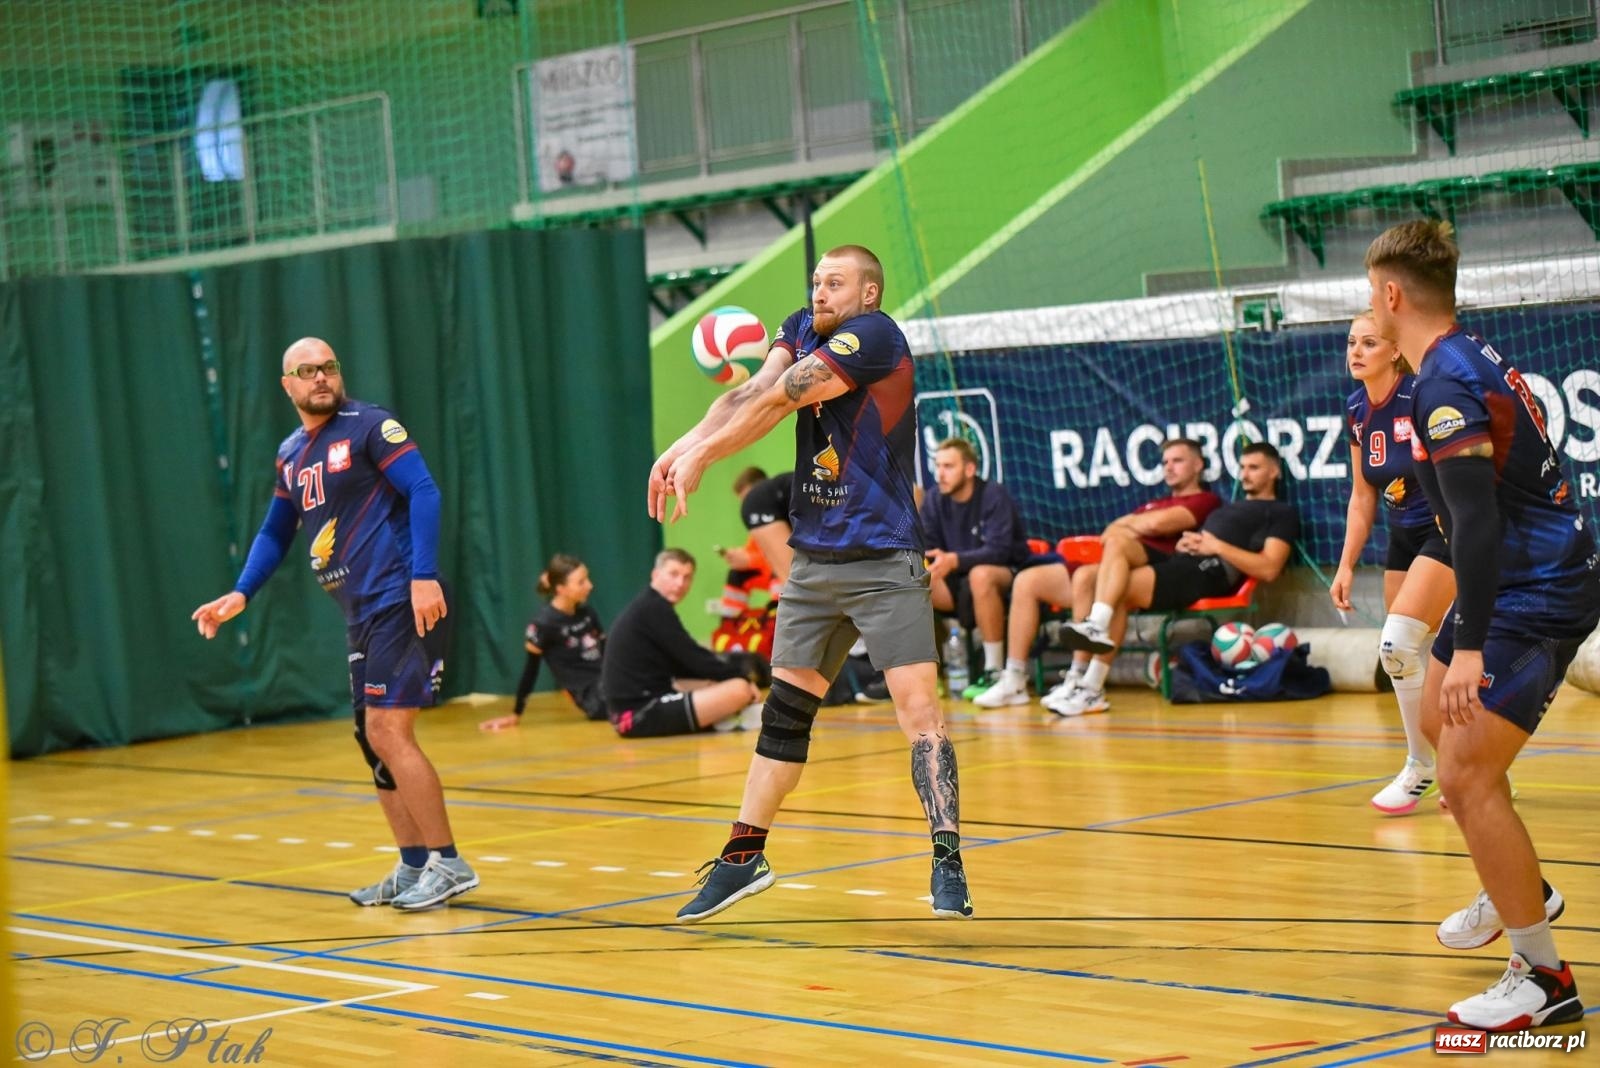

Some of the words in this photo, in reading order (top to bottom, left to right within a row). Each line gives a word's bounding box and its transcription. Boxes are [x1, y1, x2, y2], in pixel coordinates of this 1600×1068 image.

[1050, 398, 1348, 489] RACBÓRZ
[1369, 430, 1386, 467] 9
[1429, 418, 1466, 436] BRIGADE
[297, 460, 326, 512] 21
